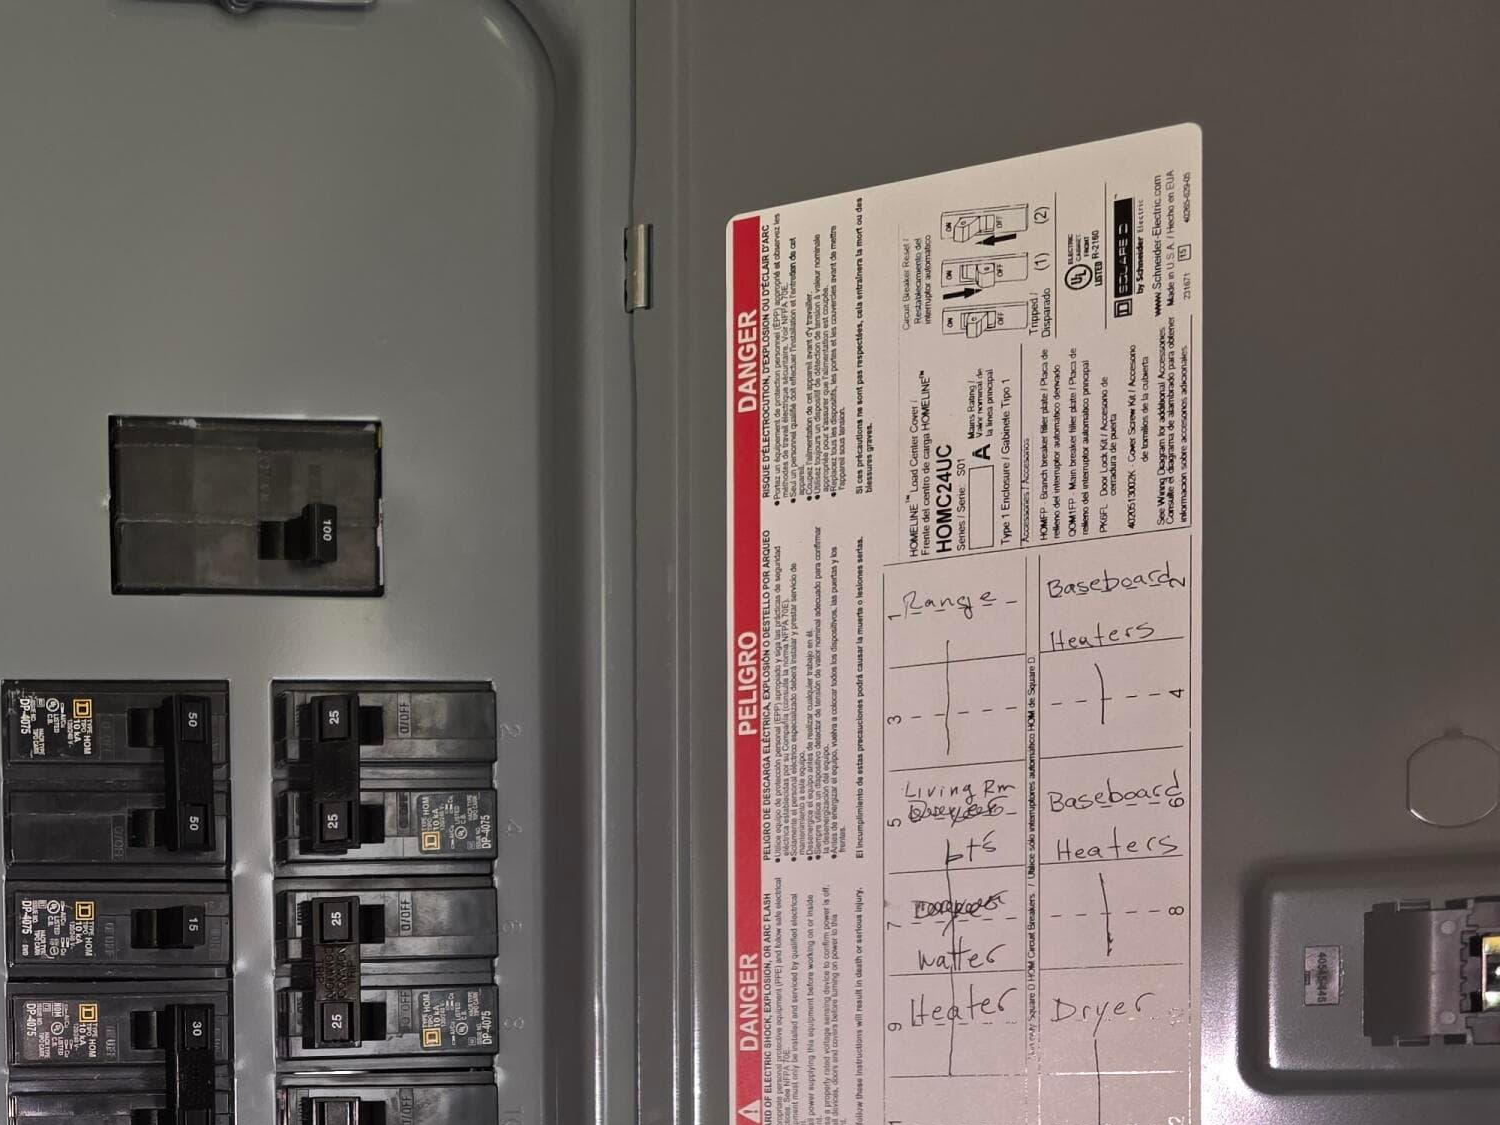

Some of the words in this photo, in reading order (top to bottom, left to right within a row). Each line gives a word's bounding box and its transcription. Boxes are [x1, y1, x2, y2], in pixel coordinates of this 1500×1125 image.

[1034, 206, 1049, 224] (2)
[762, 225, 770, 252] D'ARC
[1153, 175, 1162, 317] www.Schneider-Electric.com
[760, 255, 770, 296] D'ÉCLAIR
[1034, 253, 1049, 270] (1)
[762, 299, 770, 311] OU
[1029, 299, 1040, 335] Tripped
[1041, 288, 1052, 337] Disparado
[762, 314, 770, 373] D'EXPLOSION
[738, 310, 757, 413] DANGER
[1001, 386, 1011, 407] Tipo
[910, 405, 918, 433] Cover
[1002, 411, 1010, 454] Gabinete
[910, 436, 918, 466] Center
[923, 433, 932, 458] carga
[972, 444, 990, 460] A
[910, 469, 918, 492] Load
[922, 461, 930, 473] de
[957, 458, 965, 476] S01
[922, 476, 930, 505] centro
[936, 444, 952, 553] HOMC24UC
[1002, 463, 1010, 510] Enclosure
[922, 508, 930, 522] del
[323, 520, 332, 541] 100
[922, 525, 930, 556] Frente
[957, 521, 965, 551] Series
[1001, 521, 1011, 544] Type
[762, 530, 771, 568] ARQUEO
[762, 571, 770, 589] POR
[1048, 560, 1170, 598] Baseboard
[762, 592, 770, 639] DESTELLO
[903, 590, 996, 620] Range
[1050, 622, 1154, 652] Heaters
[738, 632, 757, 735] PELIGRO
[761, 650, 770, 700] EXPLOSIÓN
[1170, 688, 1184, 699] 4
[20, 699, 30, 734] DP-4075
[188, 712, 198, 727] 50
[329, 710, 339, 725] 25
[761, 702, 772, 753] ELÉCTRICA,
[888, 715, 902, 725] 3
[905, 782, 977, 803] Living
[984, 780, 1016, 794] Rm
[1049, 769, 1182, 813] Baseboard
[1169, 798, 1184, 808] 6
[189, 816, 199, 831] 50
[328, 814, 338, 829] 25
[763, 810, 770, 822] DE
[888, 819, 901, 827] 5
[481, 815, 491, 849] DP-4075
[1057, 827, 1178, 860] Heaters
[331, 912, 342, 926] 25
[763, 893, 771, 922] FLASH
[1168, 906, 1184, 916] 8
[189, 917, 198, 931] 15
[763, 925, 771, 942] ARC
[888, 922, 901, 930] 7
[763, 944, 772, 958] OR
[763, 961, 773, 1012] EXPLOSION,
[739, 953, 758, 1050] DANGER
[911, 984, 1018, 1020] Heater
[1051, 992, 1155, 1038] Dryer
[26, 1003, 37, 1036] DP-4075
[192, 1021, 202, 1036] 30
[331, 1014, 343, 1028] 25
[481, 1010, 493, 1045] DP-4075
[764, 1015, 773, 1048] SHOCK,
[888, 1022, 902, 1032] 9
[764, 1051, 772, 1093] ELECTRIC
[764, 1096, 772, 1109] OF
